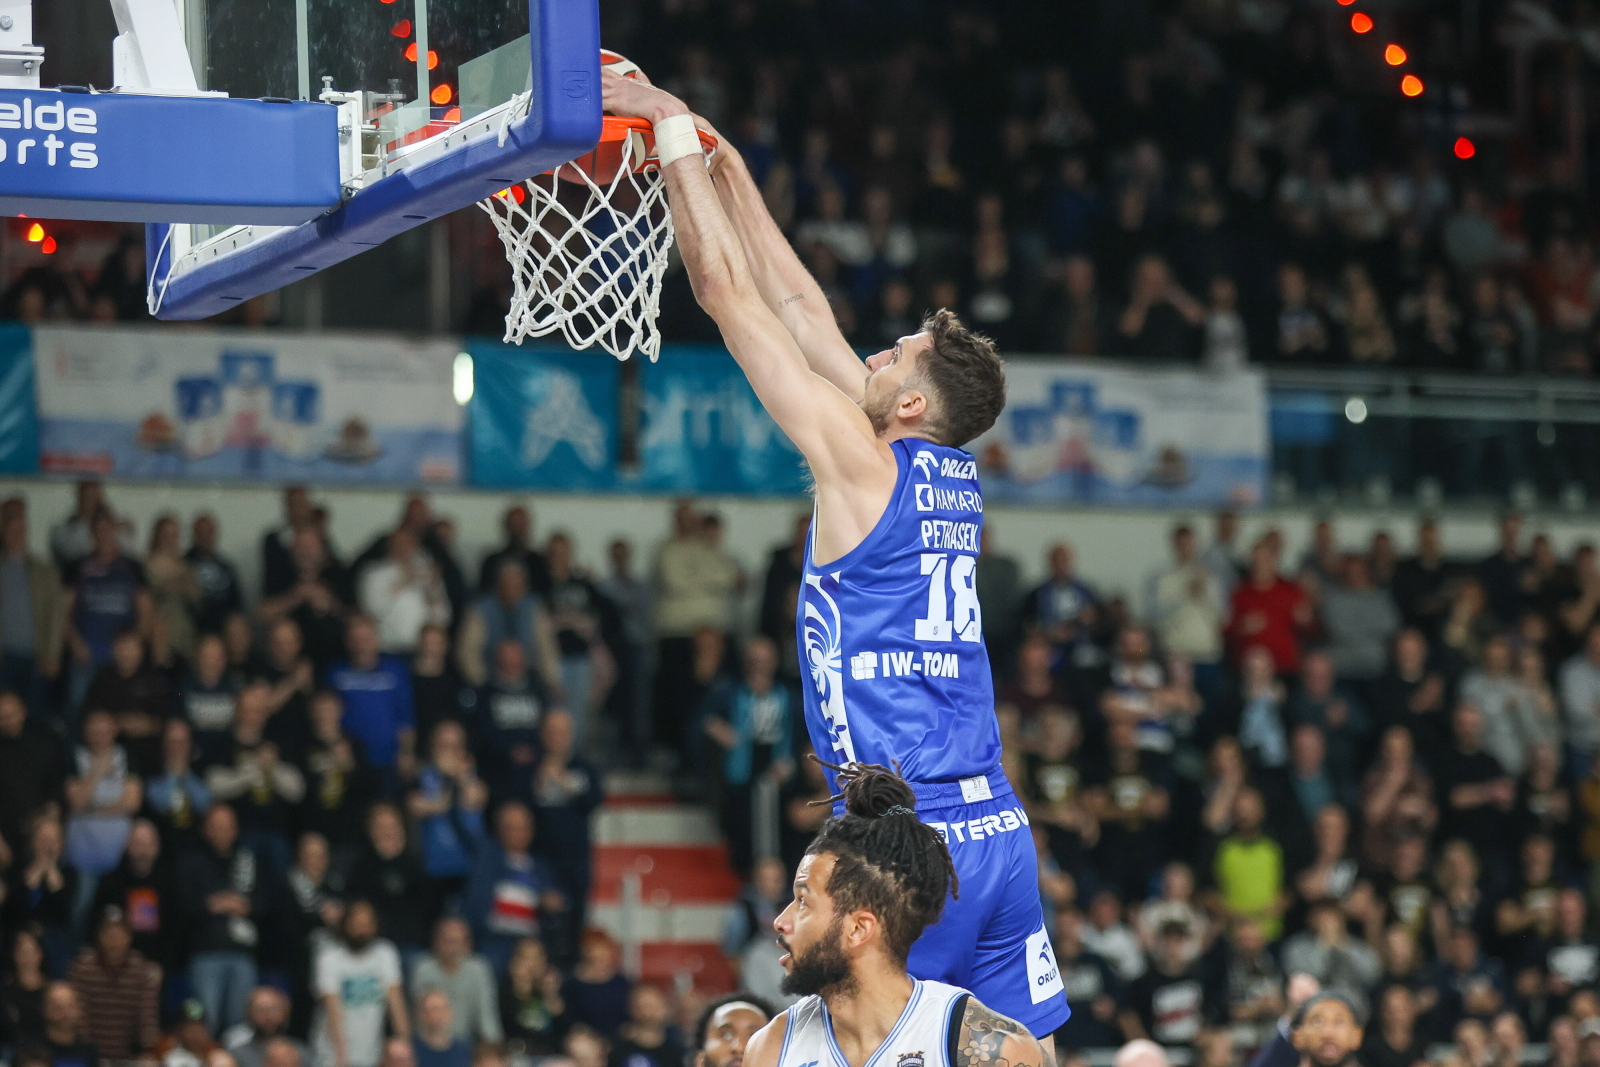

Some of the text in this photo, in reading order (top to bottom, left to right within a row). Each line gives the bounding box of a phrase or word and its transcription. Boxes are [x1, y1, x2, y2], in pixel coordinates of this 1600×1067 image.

[0, 133, 98, 169] rts
[921, 520, 979, 552] PETRASEK
[915, 553, 982, 643] 18
[882, 651, 959, 679] IW-TOM
